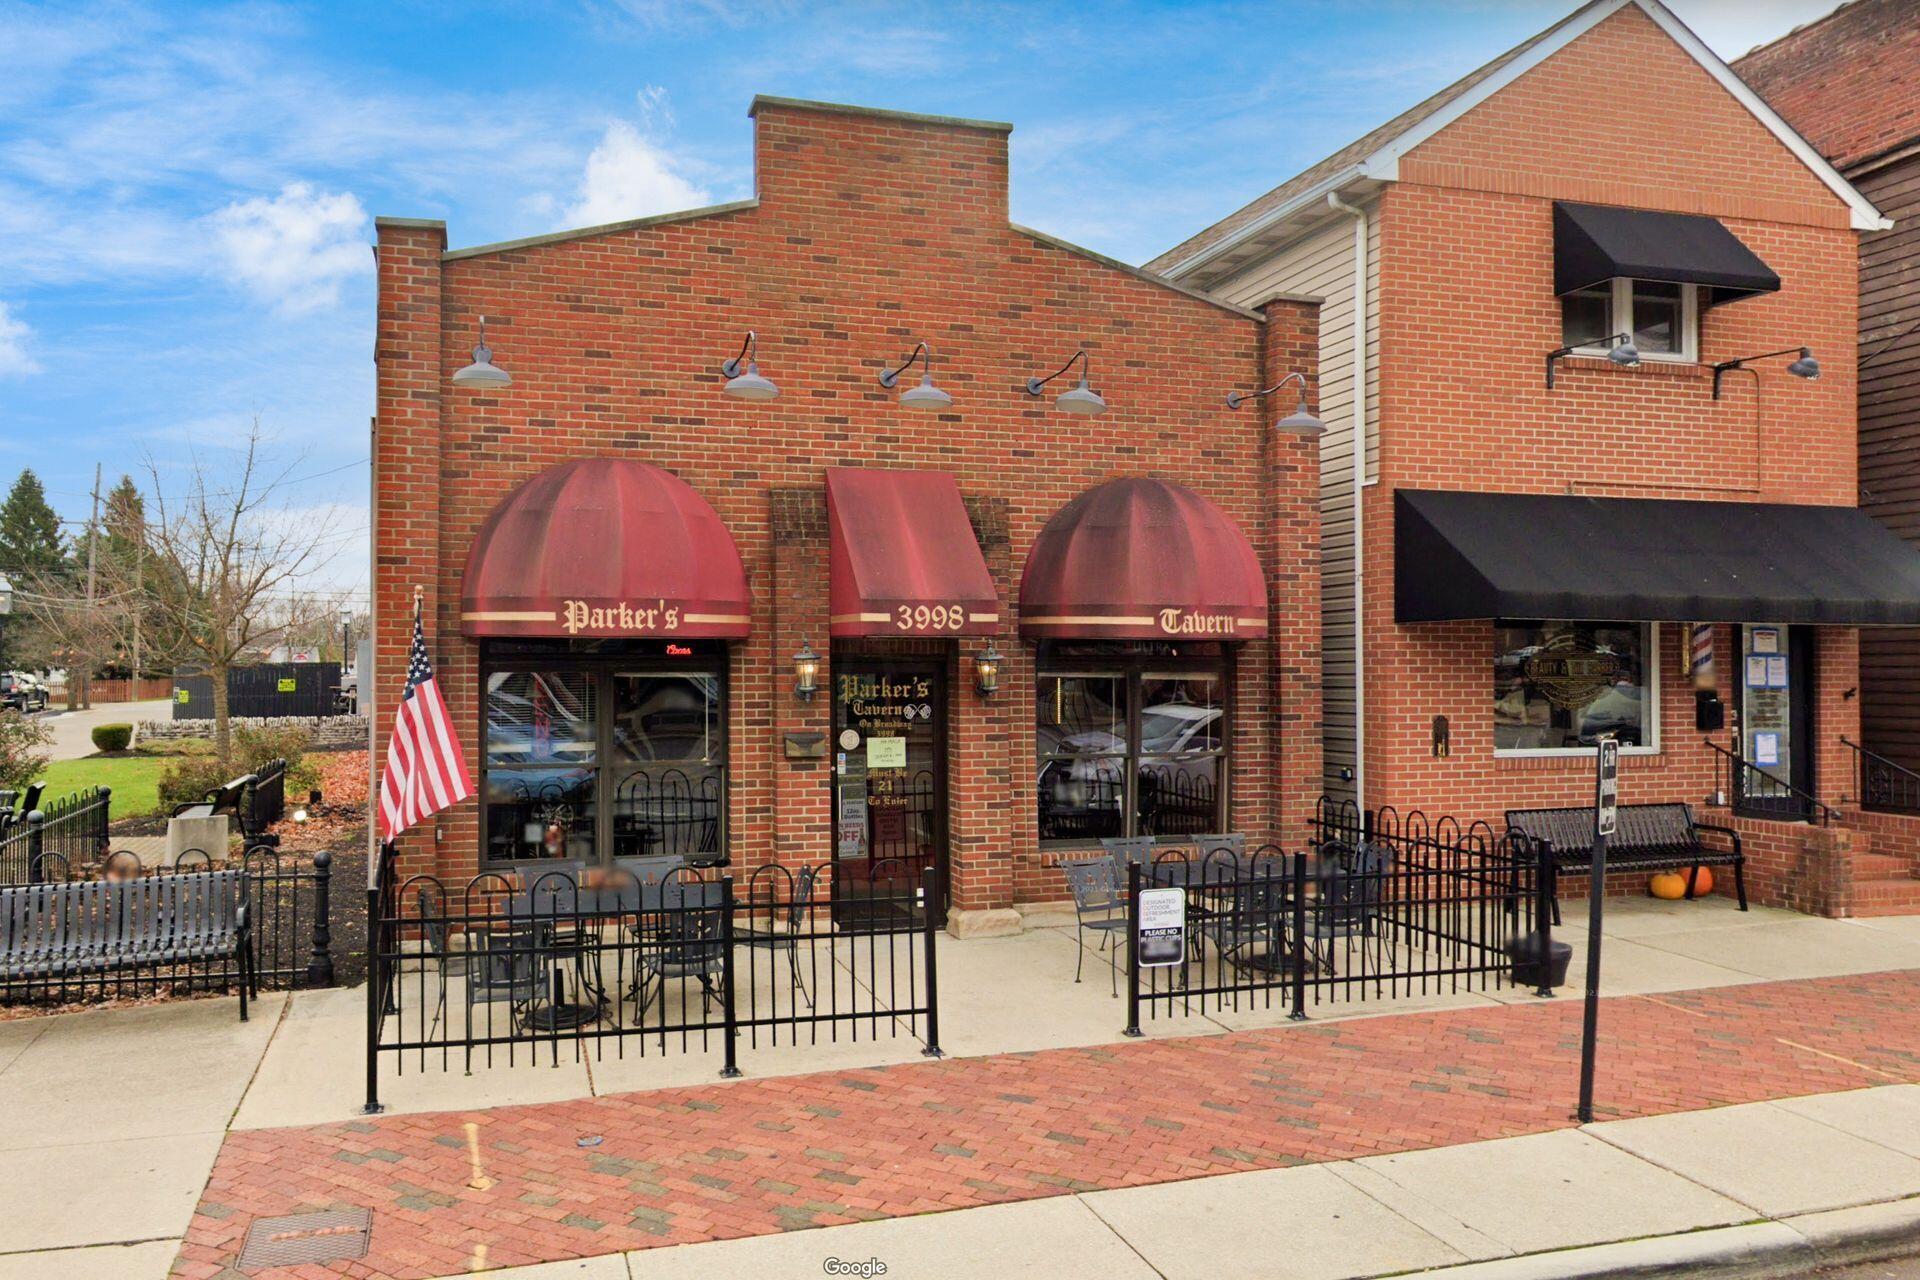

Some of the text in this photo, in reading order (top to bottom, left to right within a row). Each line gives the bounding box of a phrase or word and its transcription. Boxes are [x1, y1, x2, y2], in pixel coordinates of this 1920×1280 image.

[563, 599, 679, 634] Parker's
[896, 604, 964, 630] 3998
[1159, 608, 1235, 634] Tavern
[838, 674, 930, 704] Parker's
[853, 700, 903, 716] Tavern
[859, 718, 872, 728] On
[878, 781, 893, 791] 21
[867, 796, 880, 806] To
